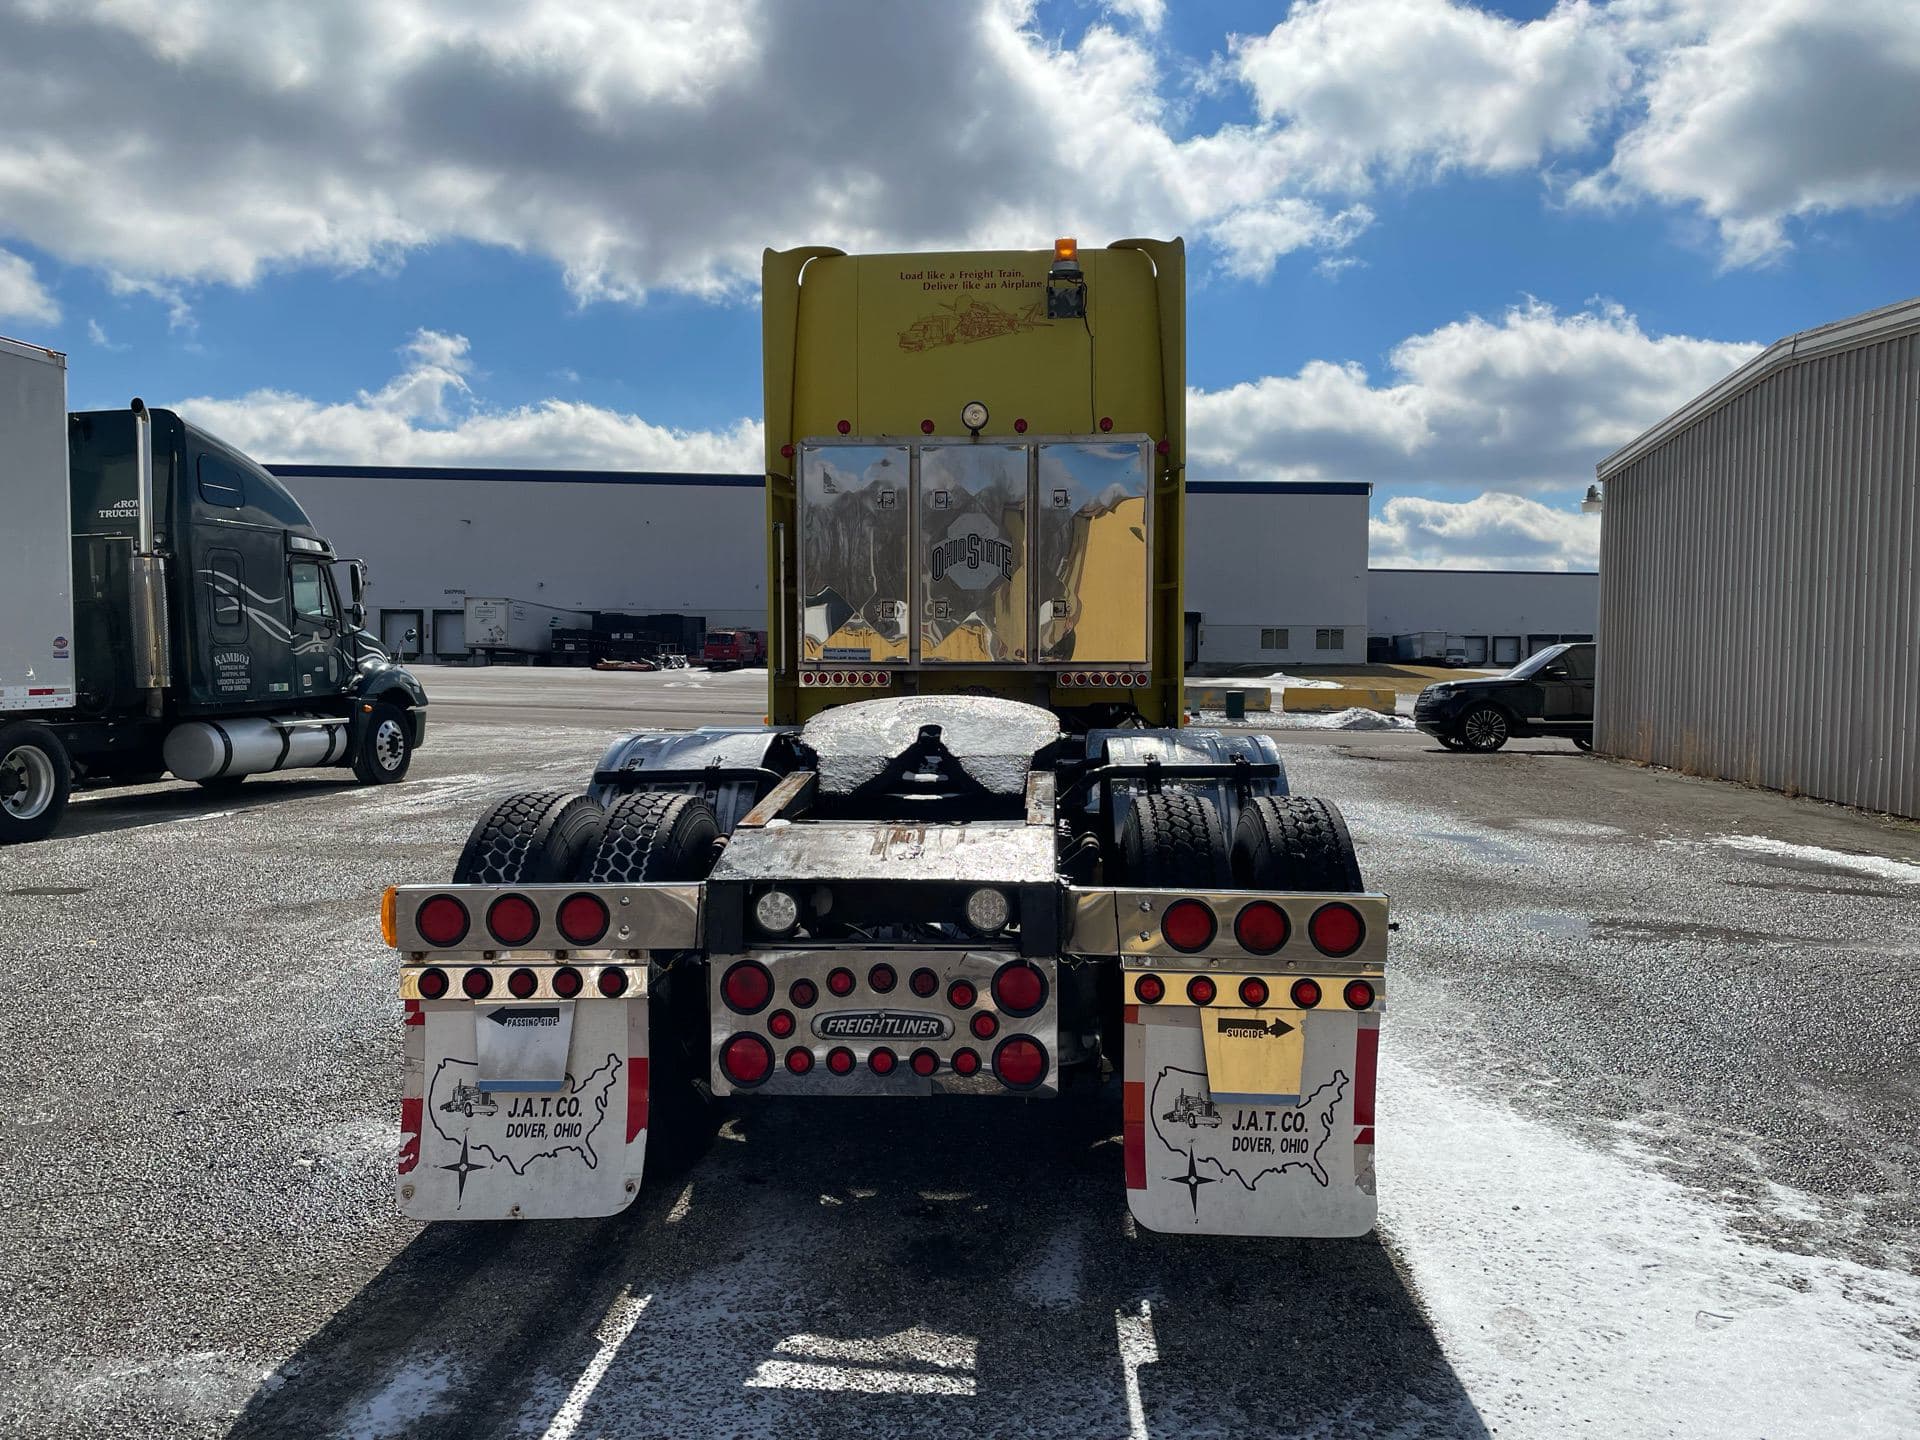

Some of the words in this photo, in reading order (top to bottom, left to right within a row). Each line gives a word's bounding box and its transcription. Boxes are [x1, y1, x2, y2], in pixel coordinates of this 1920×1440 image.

[900, 271, 923, 280] Load
[927, 270, 945, 280] like
[960, 270, 993, 280] Freight
[923, 281, 959, 291] Deliver
[963, 280, 981, 290] like
[214, 652, 250, 666] KAMBOJ
[507, 1017, 539, 1027] PASSING
[540, 1017, 558, 1027] SIDE
[826, 1018, 939, 1034] FREIGHTLINER
[1226, 1028, 1264, 1039] SUICIDE
[506, 1123, 549, 1140] DOVER,
[553, 1122, 582, 1138] OHIO
[1231, 1136, 1276, 1155] DOVER,
[1280, 1137, 1309, 1154] OHIO
